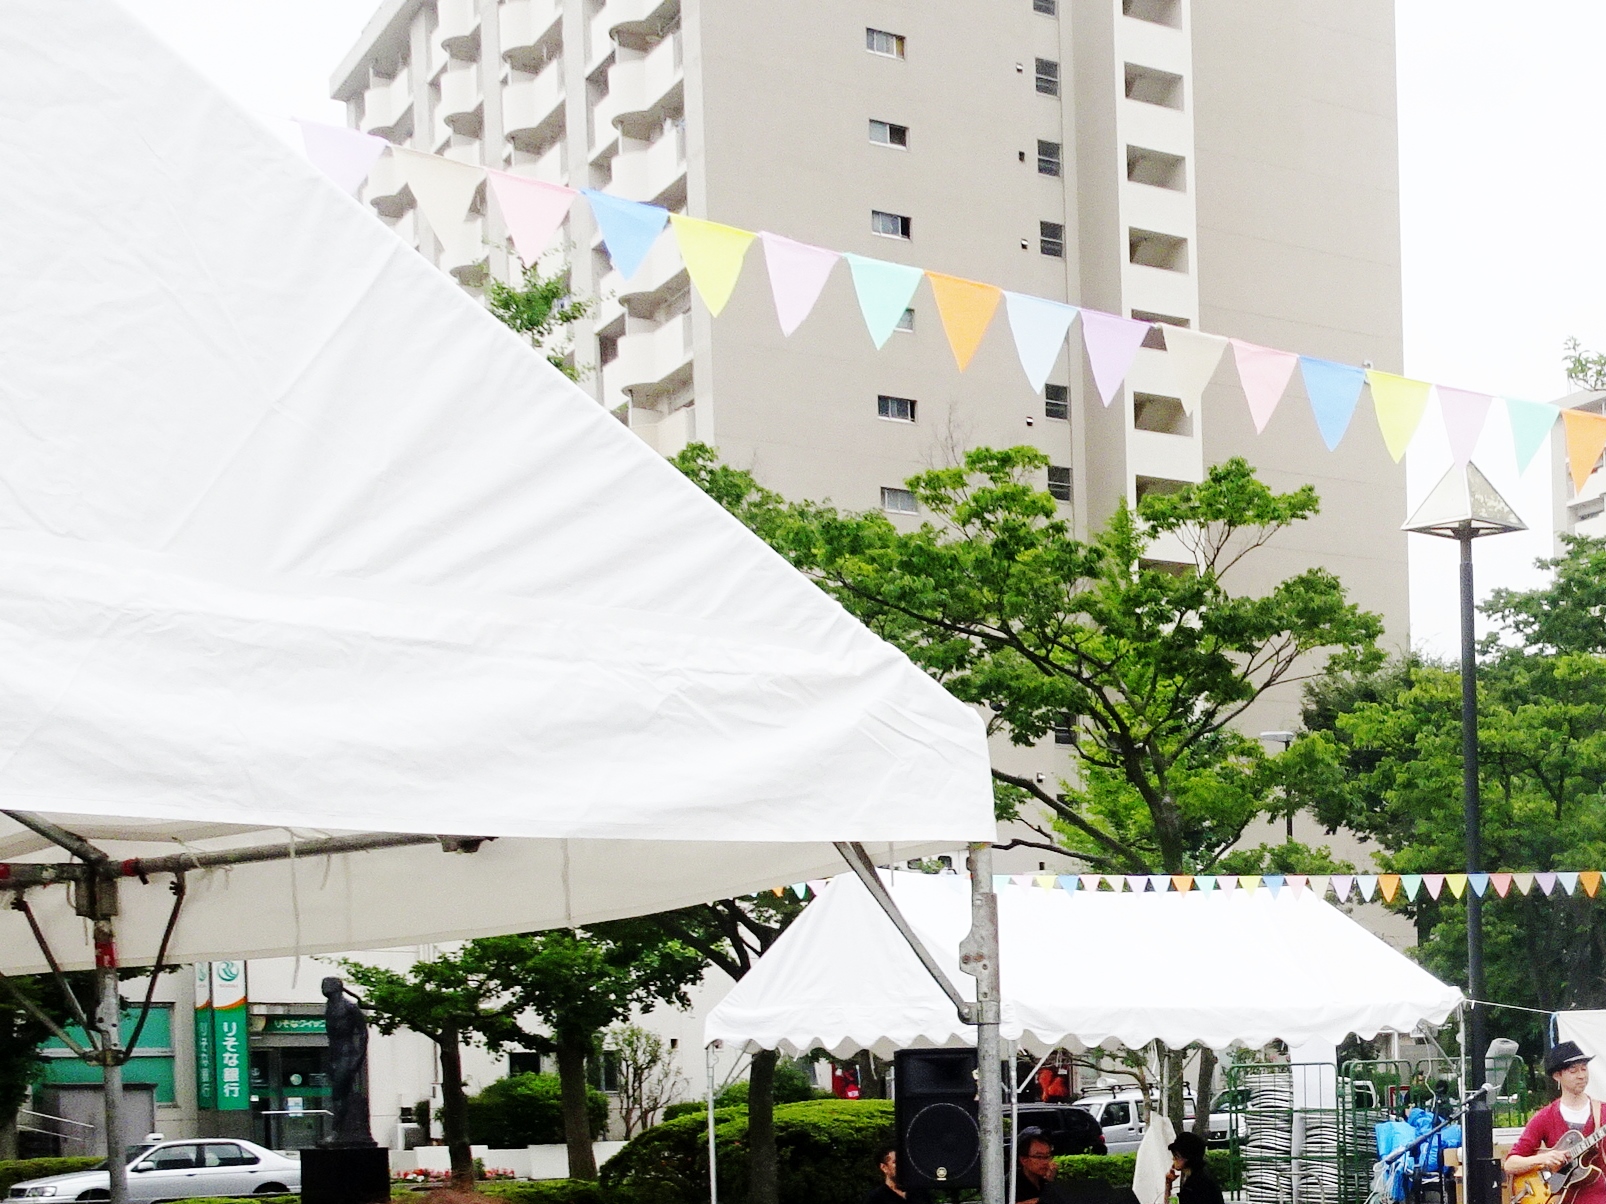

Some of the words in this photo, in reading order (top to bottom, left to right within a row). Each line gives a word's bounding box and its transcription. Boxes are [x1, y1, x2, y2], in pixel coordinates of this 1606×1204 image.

[222, 1021, 241, 1098] りそな銀行
